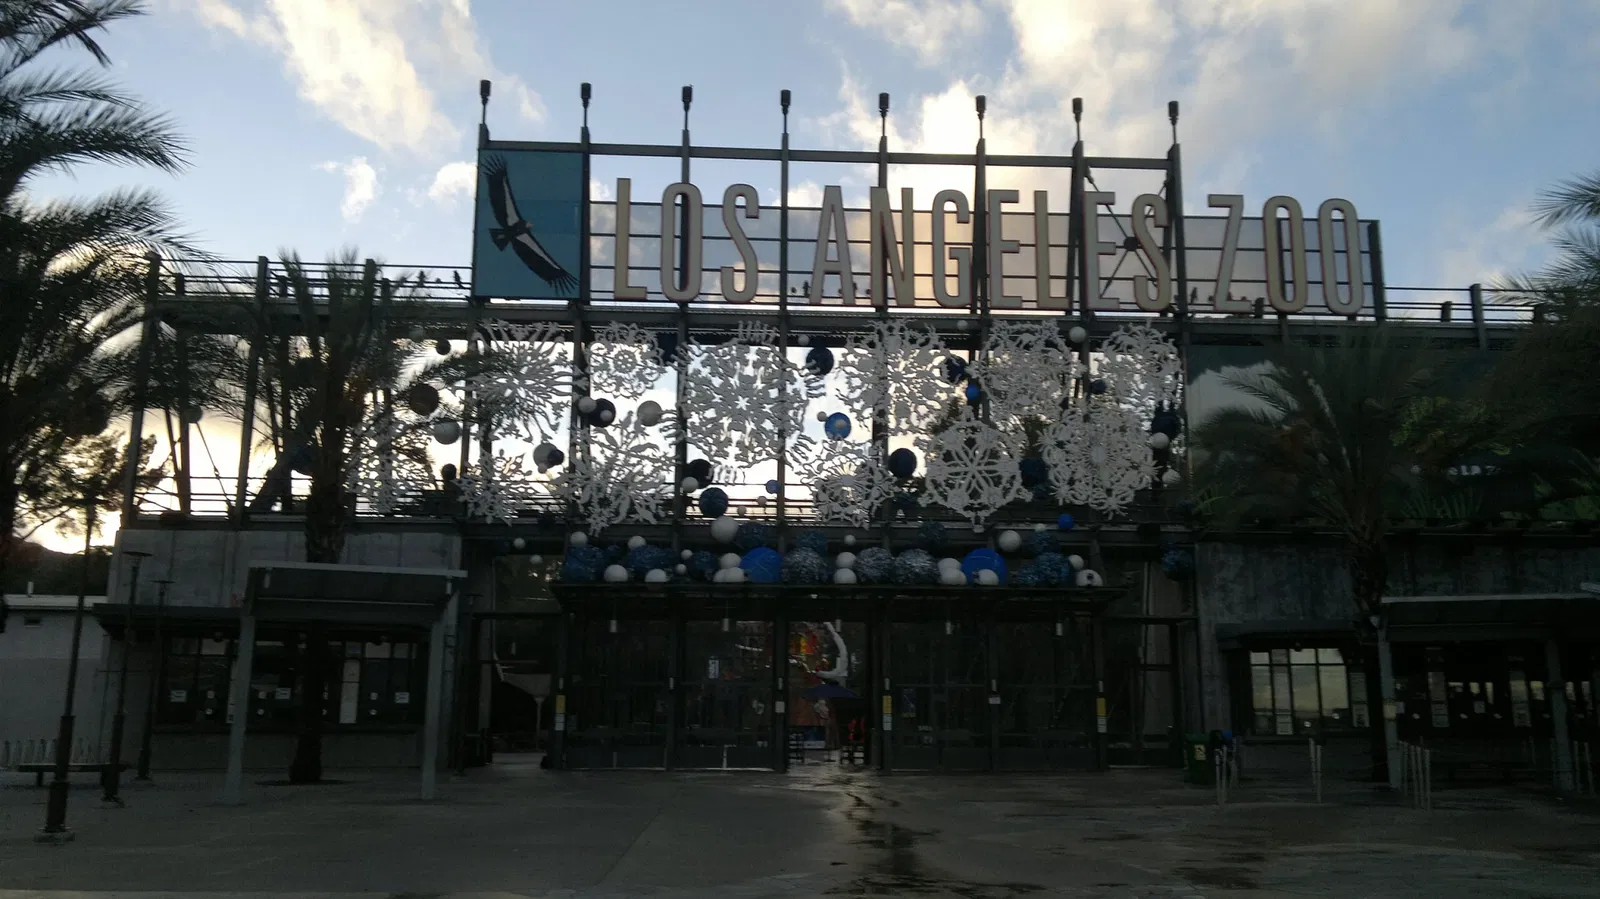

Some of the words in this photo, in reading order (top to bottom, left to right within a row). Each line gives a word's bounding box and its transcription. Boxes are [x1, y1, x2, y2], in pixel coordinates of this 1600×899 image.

[614, 178, 759, 304] LOS
[808, 185, 1171, 313] ANGELES
[1207, 194, 1364, 316] ZOO
